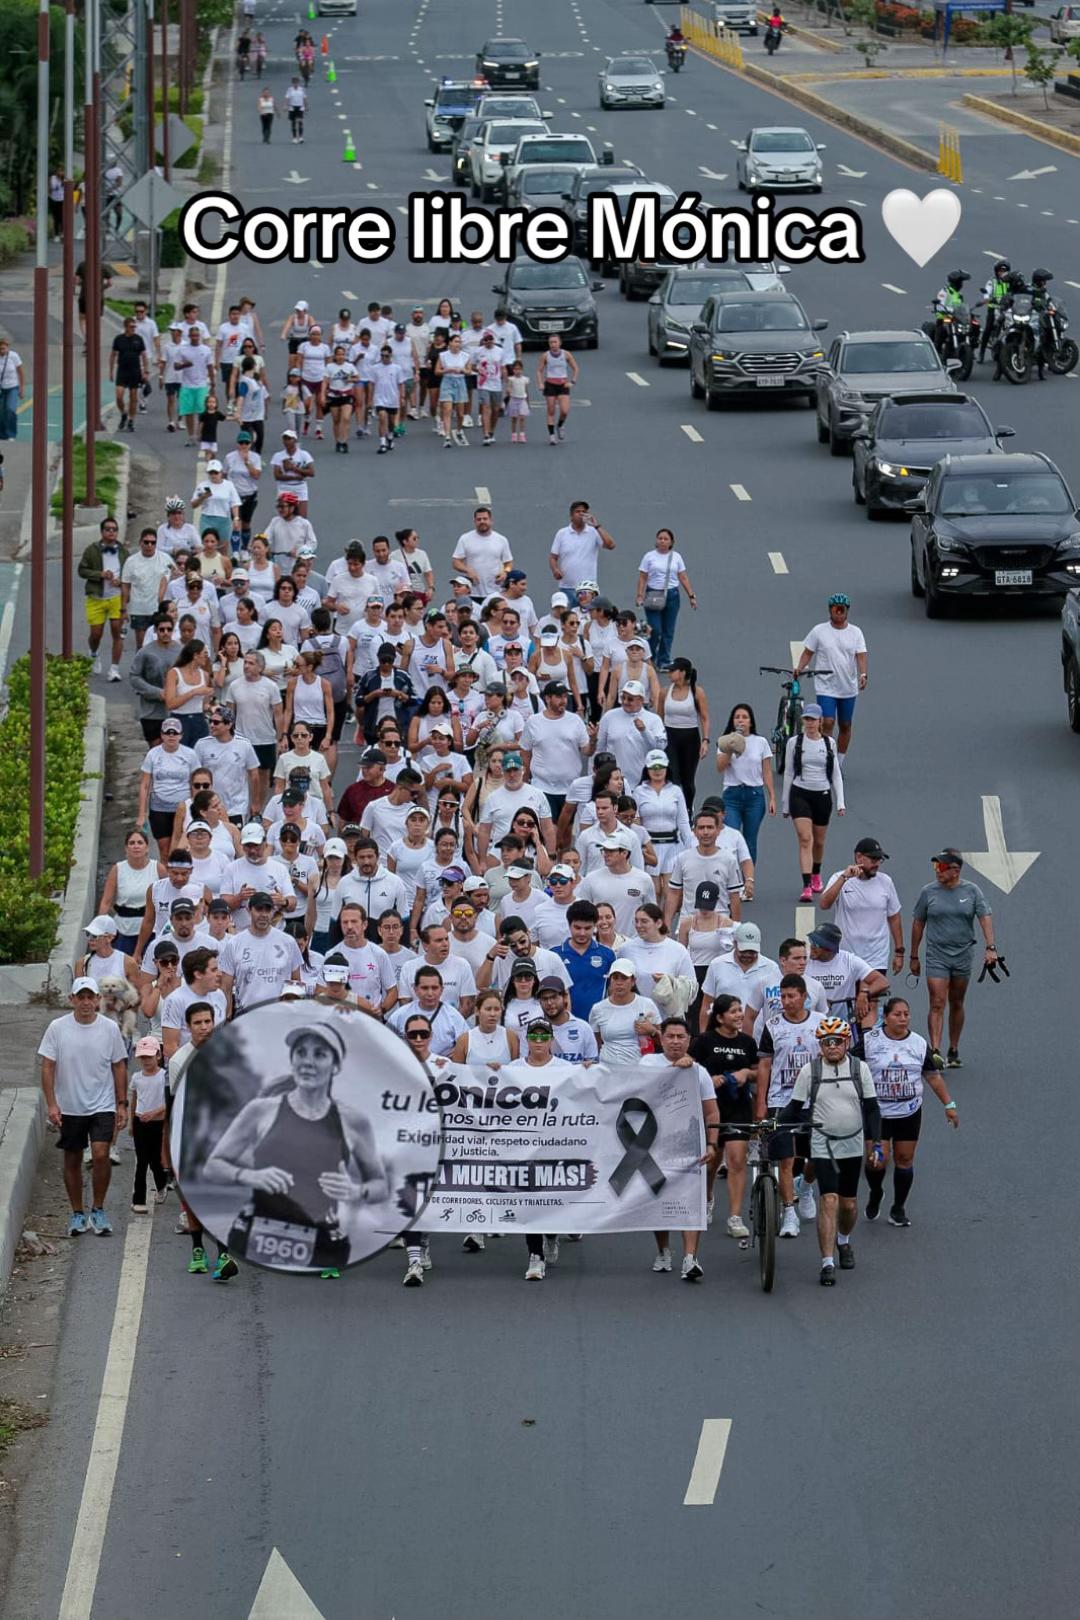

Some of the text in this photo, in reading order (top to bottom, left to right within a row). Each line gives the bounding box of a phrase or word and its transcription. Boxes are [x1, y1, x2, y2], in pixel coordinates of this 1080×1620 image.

[713, 1046, 746, 1055] CHANEL
[433, 1074, 559, 1112] ónica,
[381, 1089, 440, 1113] tu le
[442, 1112, 600, 1127] nos une en la ruta.
[467, 1135, 488, 1146] vial,
[490, 1136, 530, 1147] respeto
[532, 1137, 588, 1147] ciudadano
[452, 1146, 500, 1157] y justicia.
[452, 1163, 530, 1187] MUERTE
[534, 1160, 587, 1187] MÁS!
[431, 1196, 441, 1204] DE
[441, 1196, 485, 1205] CORREDORES,
[485, 1198, 518, 1206] CICLISTAS
[525, 1198, 565, 1206] TRIATLETAS.
[255, 1234, 308, 1261] 1960
